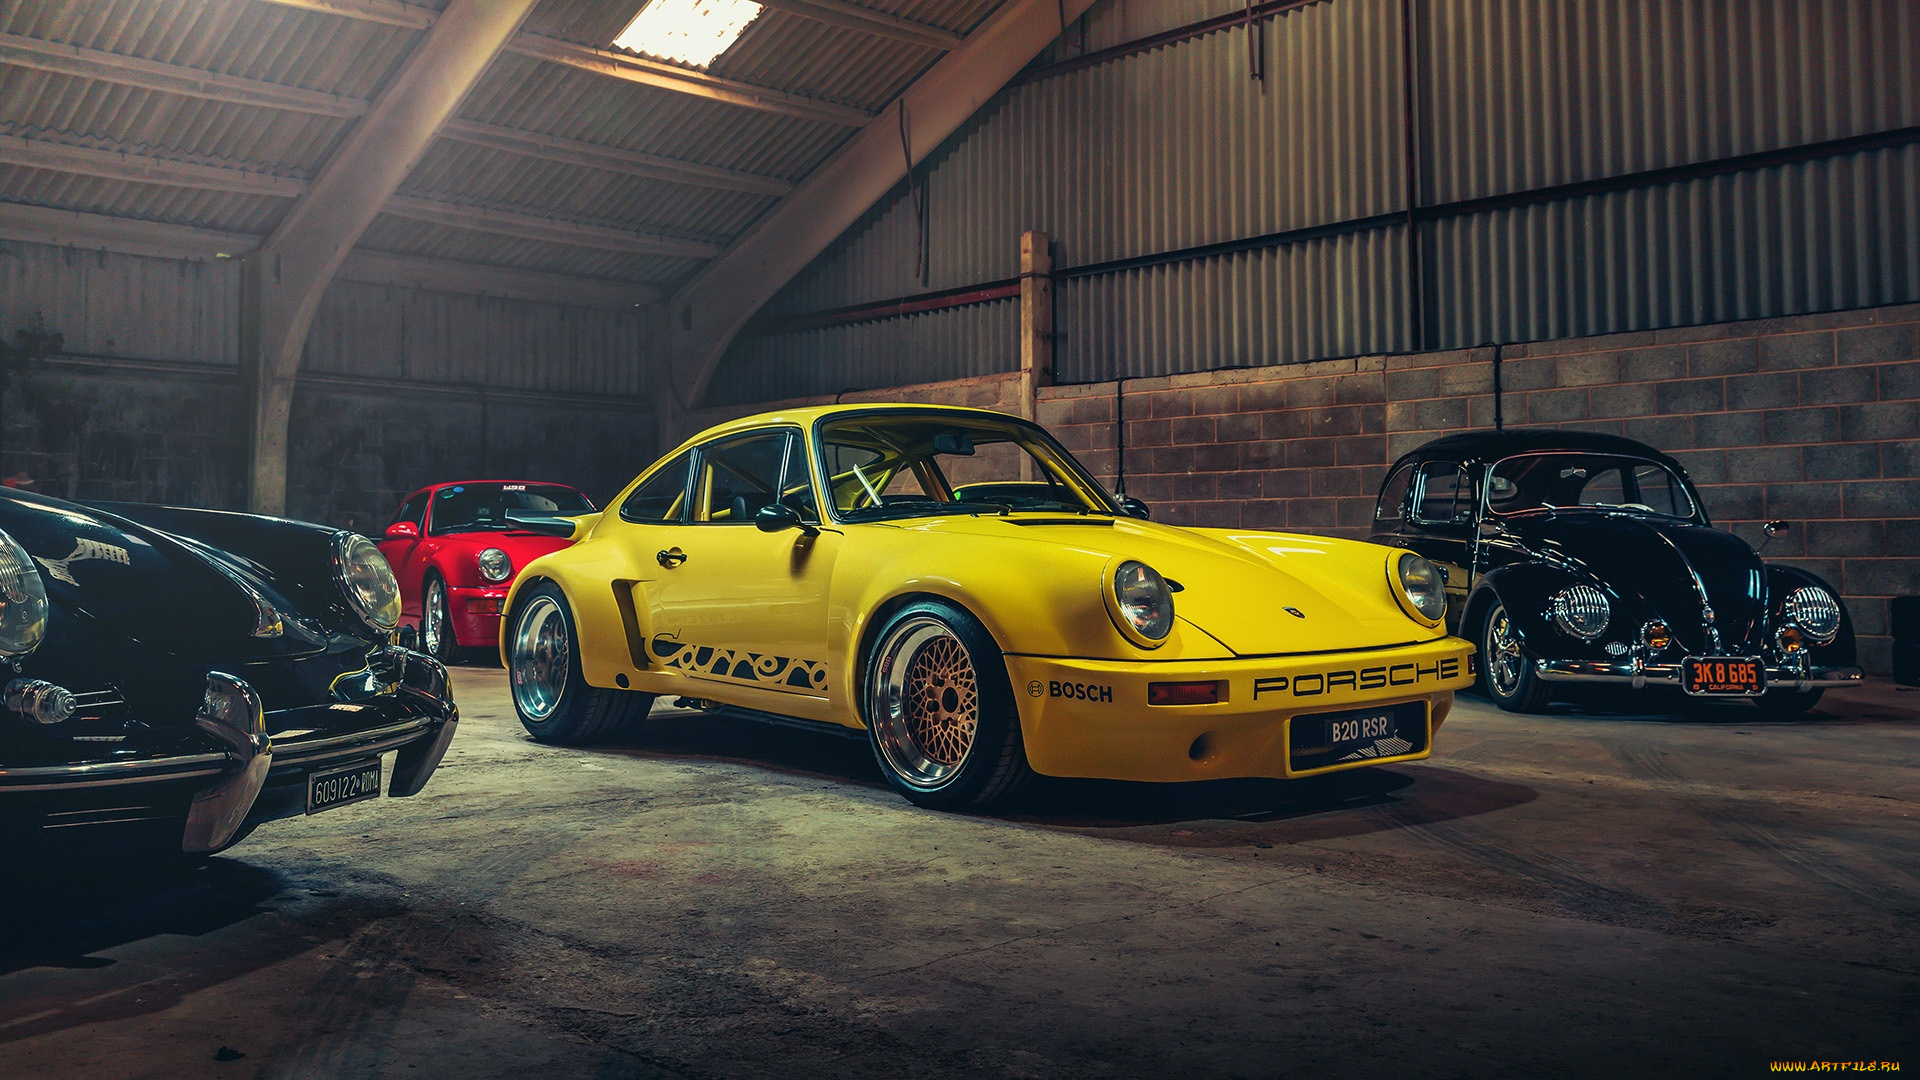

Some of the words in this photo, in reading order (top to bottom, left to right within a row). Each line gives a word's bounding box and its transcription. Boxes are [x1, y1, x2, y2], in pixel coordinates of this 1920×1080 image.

[643, 628, 829, 691] Carrera
[1693, 662, 1714, 683] 3K
[1715, 662, 1726, 683] 8
[1728, 663, 1757, 683] 685
[1049, 680, 1113, 703] BOSCH
[1253, 657, 1459, 701] PORSCHE
[1332, 719, 1359, 743] B20
[1362, 716, 1388, 738] RSR
[315, 774, 357, 804] 609122
[360, 769, 379, 793] ROMA
